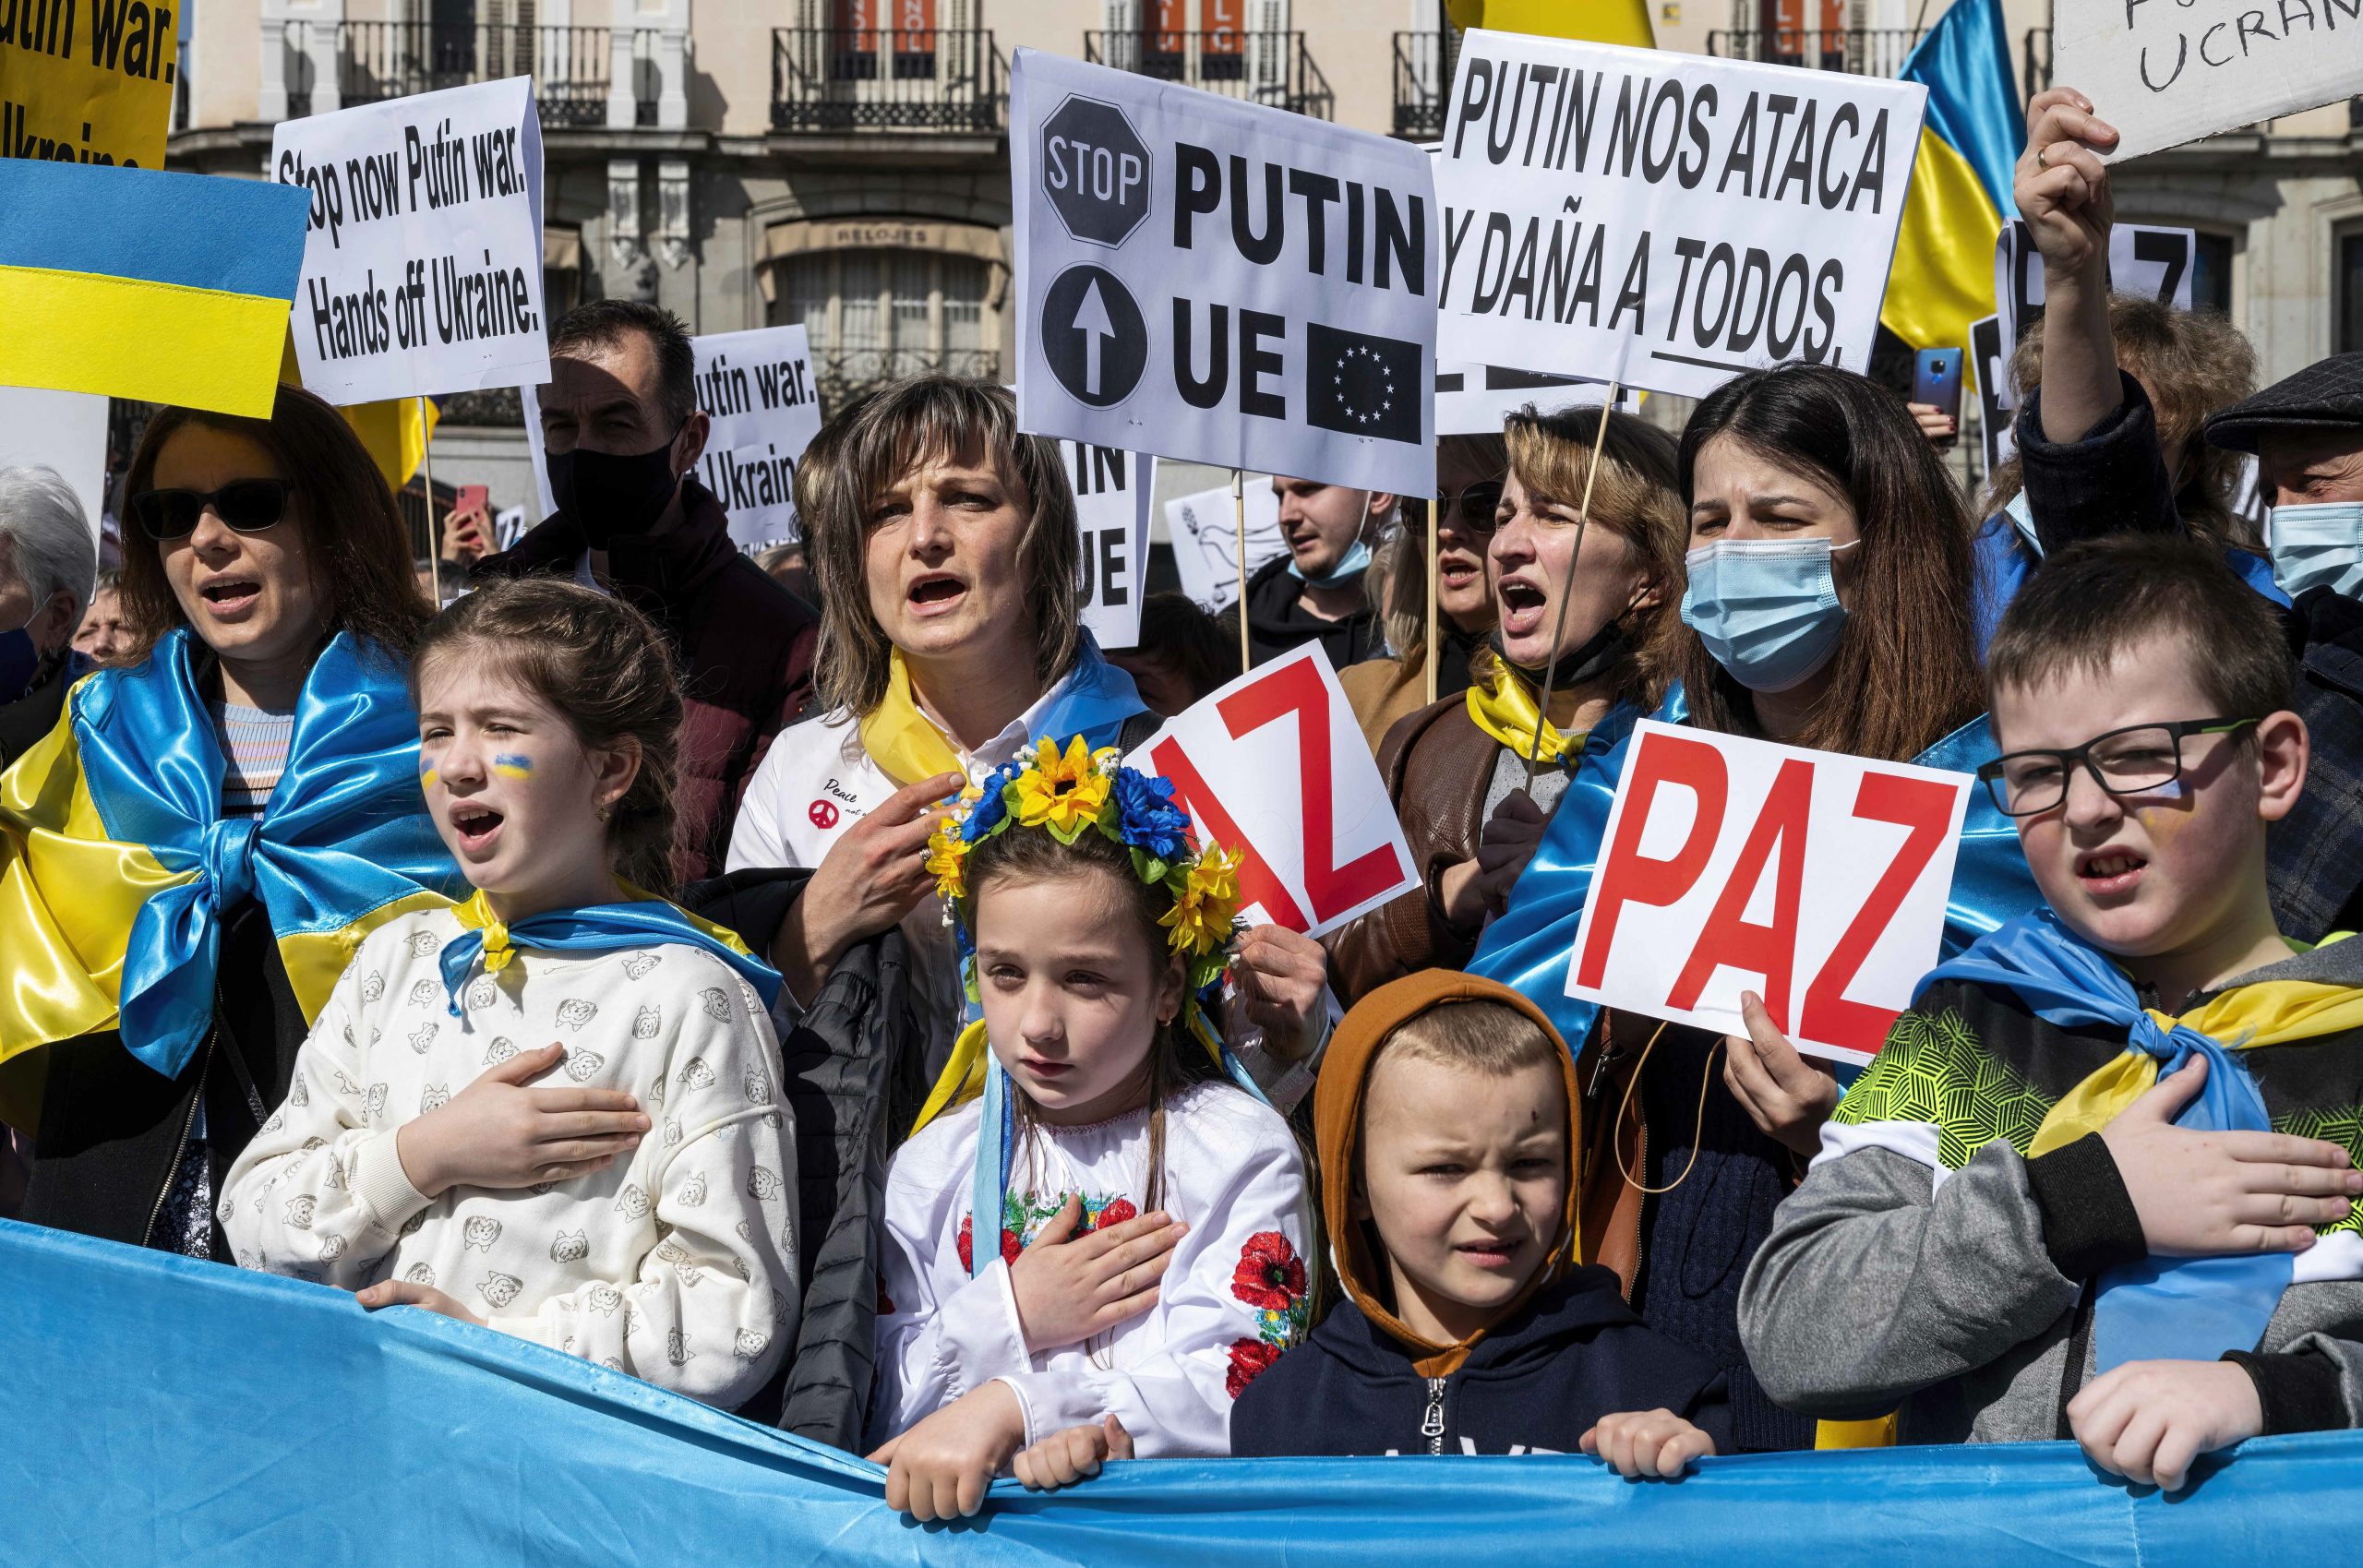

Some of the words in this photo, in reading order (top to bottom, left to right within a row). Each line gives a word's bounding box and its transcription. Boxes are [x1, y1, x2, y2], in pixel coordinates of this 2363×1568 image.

[92, 0, 175, 84] war.
[345, 151, 400, 222] now
[404, 117, 469, 212] Putin
[472, 126, 526, 199] war.
[1049, 135, 1142, 206] STOP
[1453, 57, 1603, 174] PUTIN
[1603, 75, 1720, 190] NOS
[1717, 90, 1889, 215] ATACA
[837, 228, 928, 244] RELOJES
[1173, 141, 1425, 297] PUTIN
[307, 269, 390, 361] Hands
[395, 258, 427, 351] off
[431, 248, 539, 346] Ukraine.
[1438, 206, 1475, 310] Y
[1470, 195, 1607, 328] DAÑA
[1607, 231, 1651, 336] A
[1666, 236, 1844, 367] TODOS.
[694, 354, 751, 418] utin
[753, 358, 816, 411] war.
[1172, 296, 1287, 421] UE
[705, 443, 805, 513] Ukrain
[823, 778, 858, 803] Peace
[1150, 654, 1406, 935] AZ
[1576, 731, 1959, 1054] PAZ
